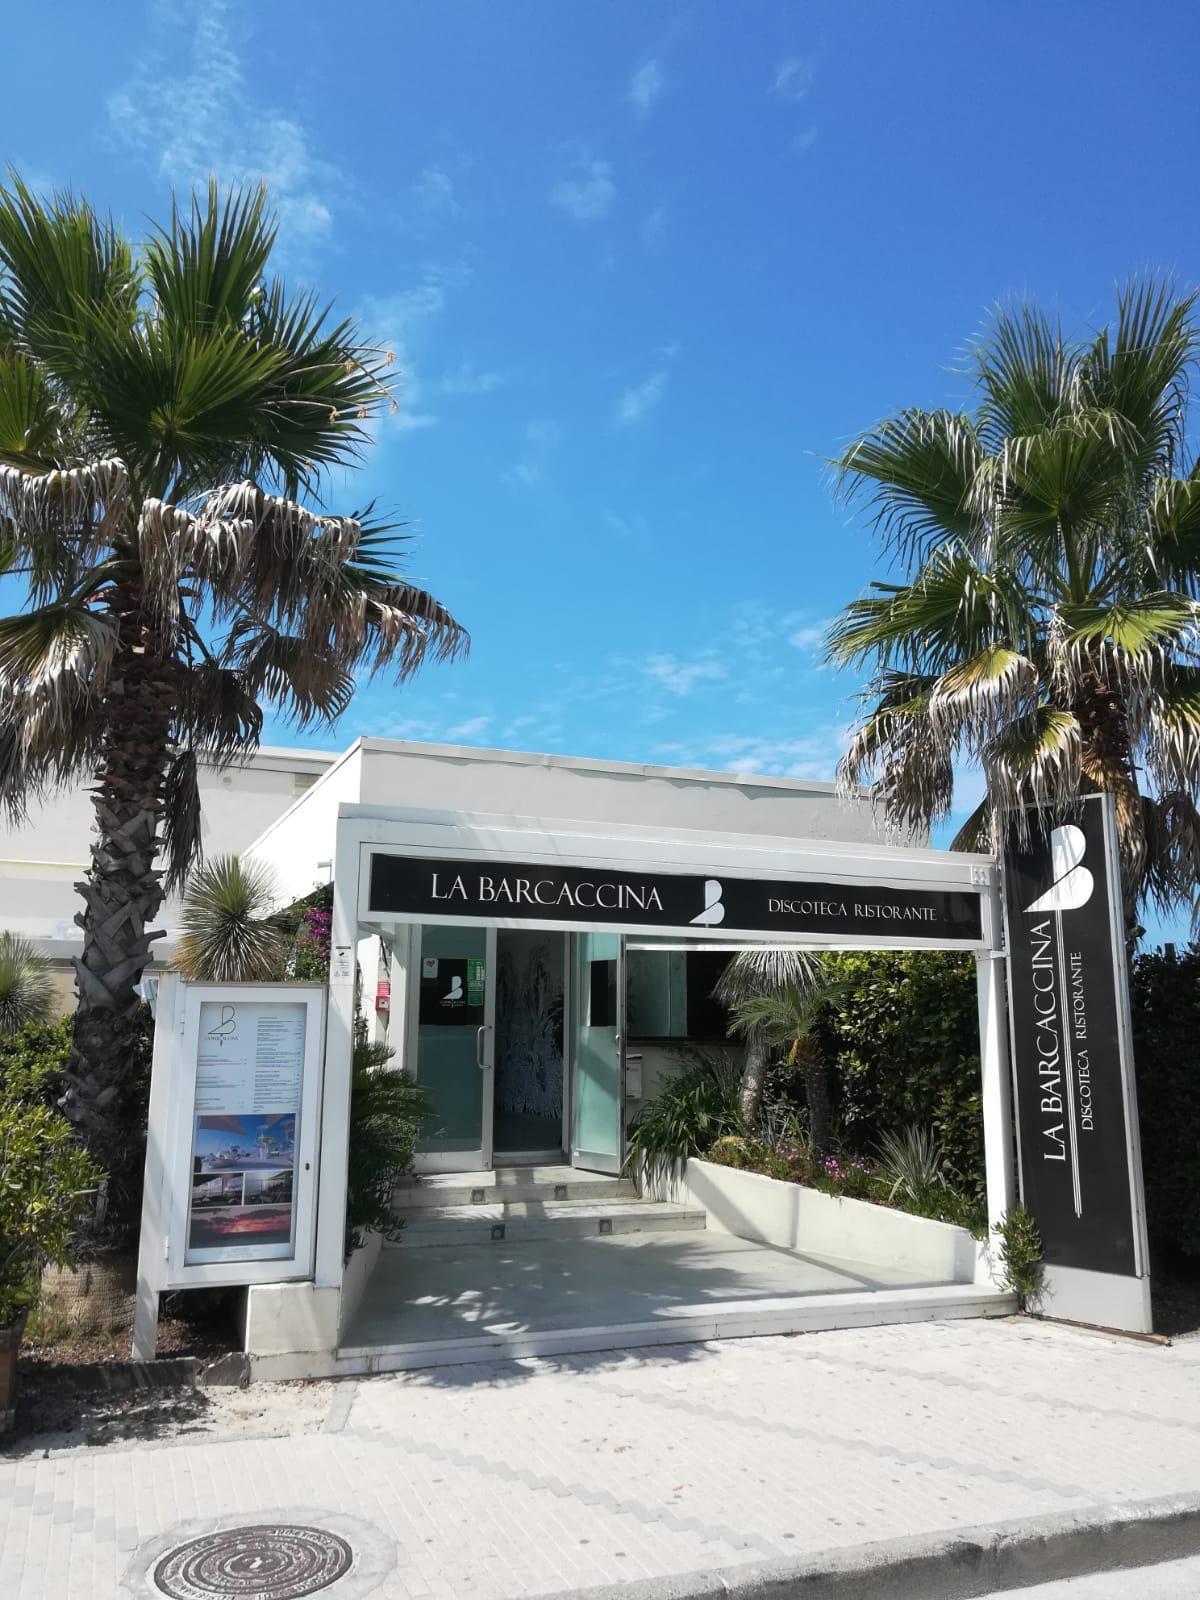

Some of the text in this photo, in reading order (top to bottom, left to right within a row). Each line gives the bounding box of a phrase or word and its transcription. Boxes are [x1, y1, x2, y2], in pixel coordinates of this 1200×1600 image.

[431, 873, 664, 911] LA BARCACCINA
[767, 898, 938, 922] DISCOTECA RISTORANTE
[1030, 919, 1067, 1162] LA BARCACCINA
[1070, 951, 1094, 1132] DISCOTECA RISTORANTE
